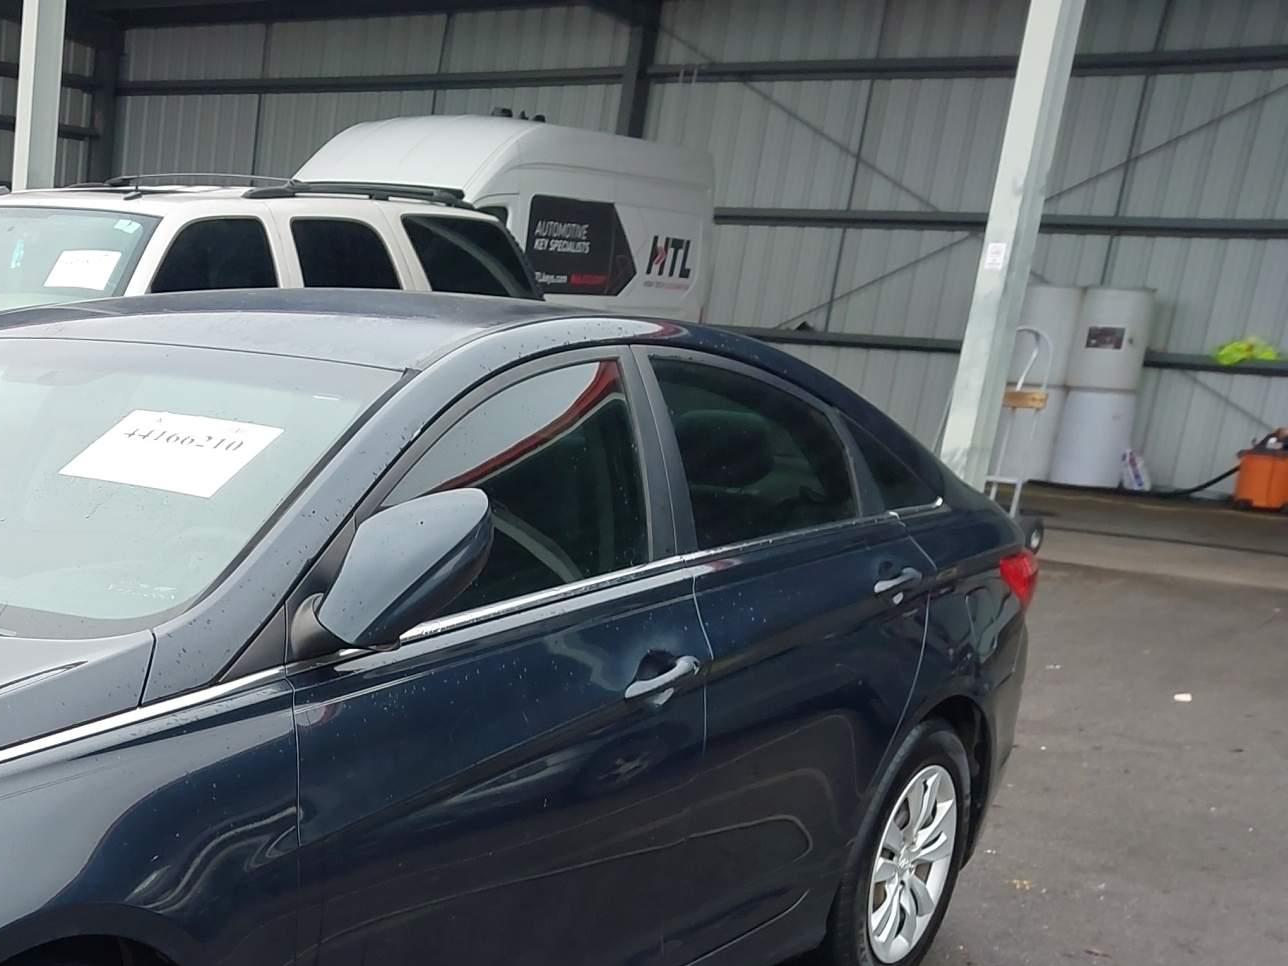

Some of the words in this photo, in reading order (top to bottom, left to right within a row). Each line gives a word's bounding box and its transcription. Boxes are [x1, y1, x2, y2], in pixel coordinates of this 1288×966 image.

[535, 220, 589, 239] AUTOMOTIVE
[534, 238, 548, 250] KEY
[548, 239, 590, 253] SPECIALISTS
[646, 235, 691, 278] HTL
[535, 271, 567, 284] TLkeys.com
[122, 427, 244, 452] 44166210
